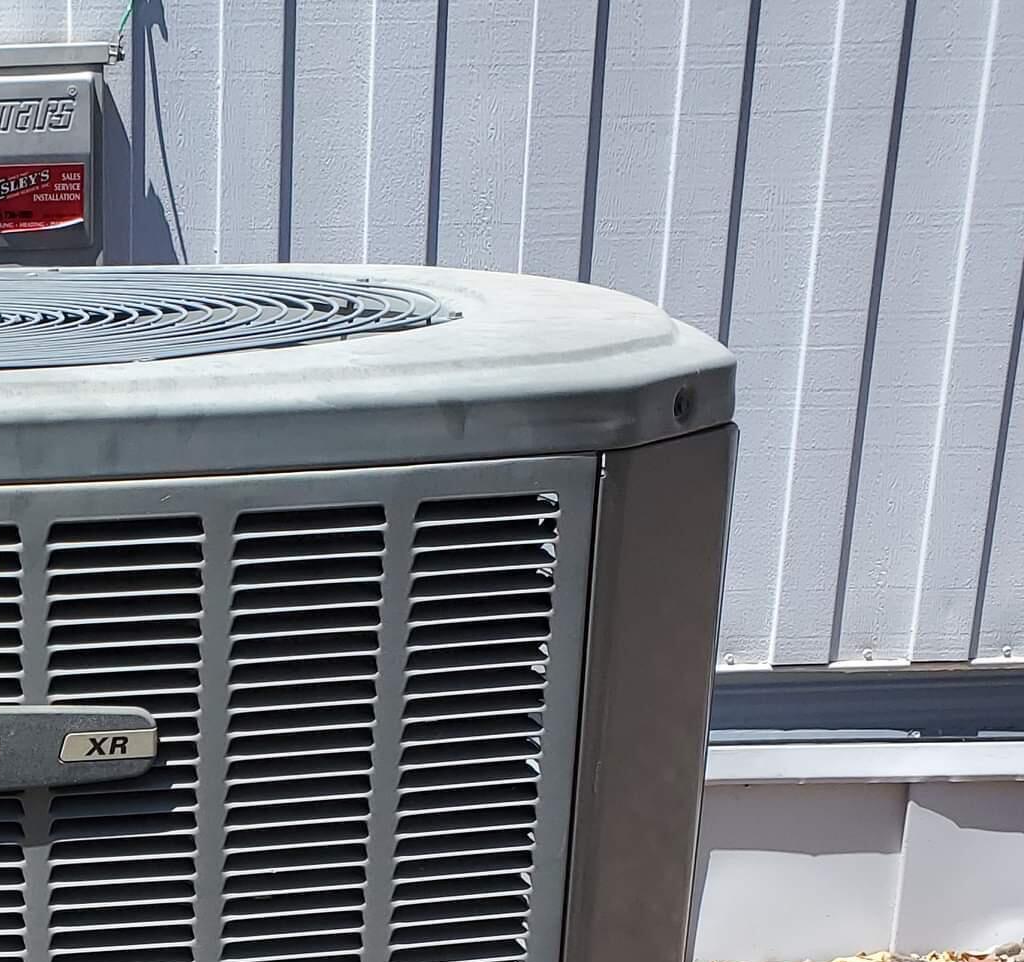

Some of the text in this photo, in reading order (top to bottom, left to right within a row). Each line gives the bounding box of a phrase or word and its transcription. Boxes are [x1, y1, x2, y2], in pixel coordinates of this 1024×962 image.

[61, 172, 81, 181] SALES
[54, 183, 81, 191] SERVICE
[33, 193, 81, 202] INSTALLATION
[85, 735, 129, 757] XR
